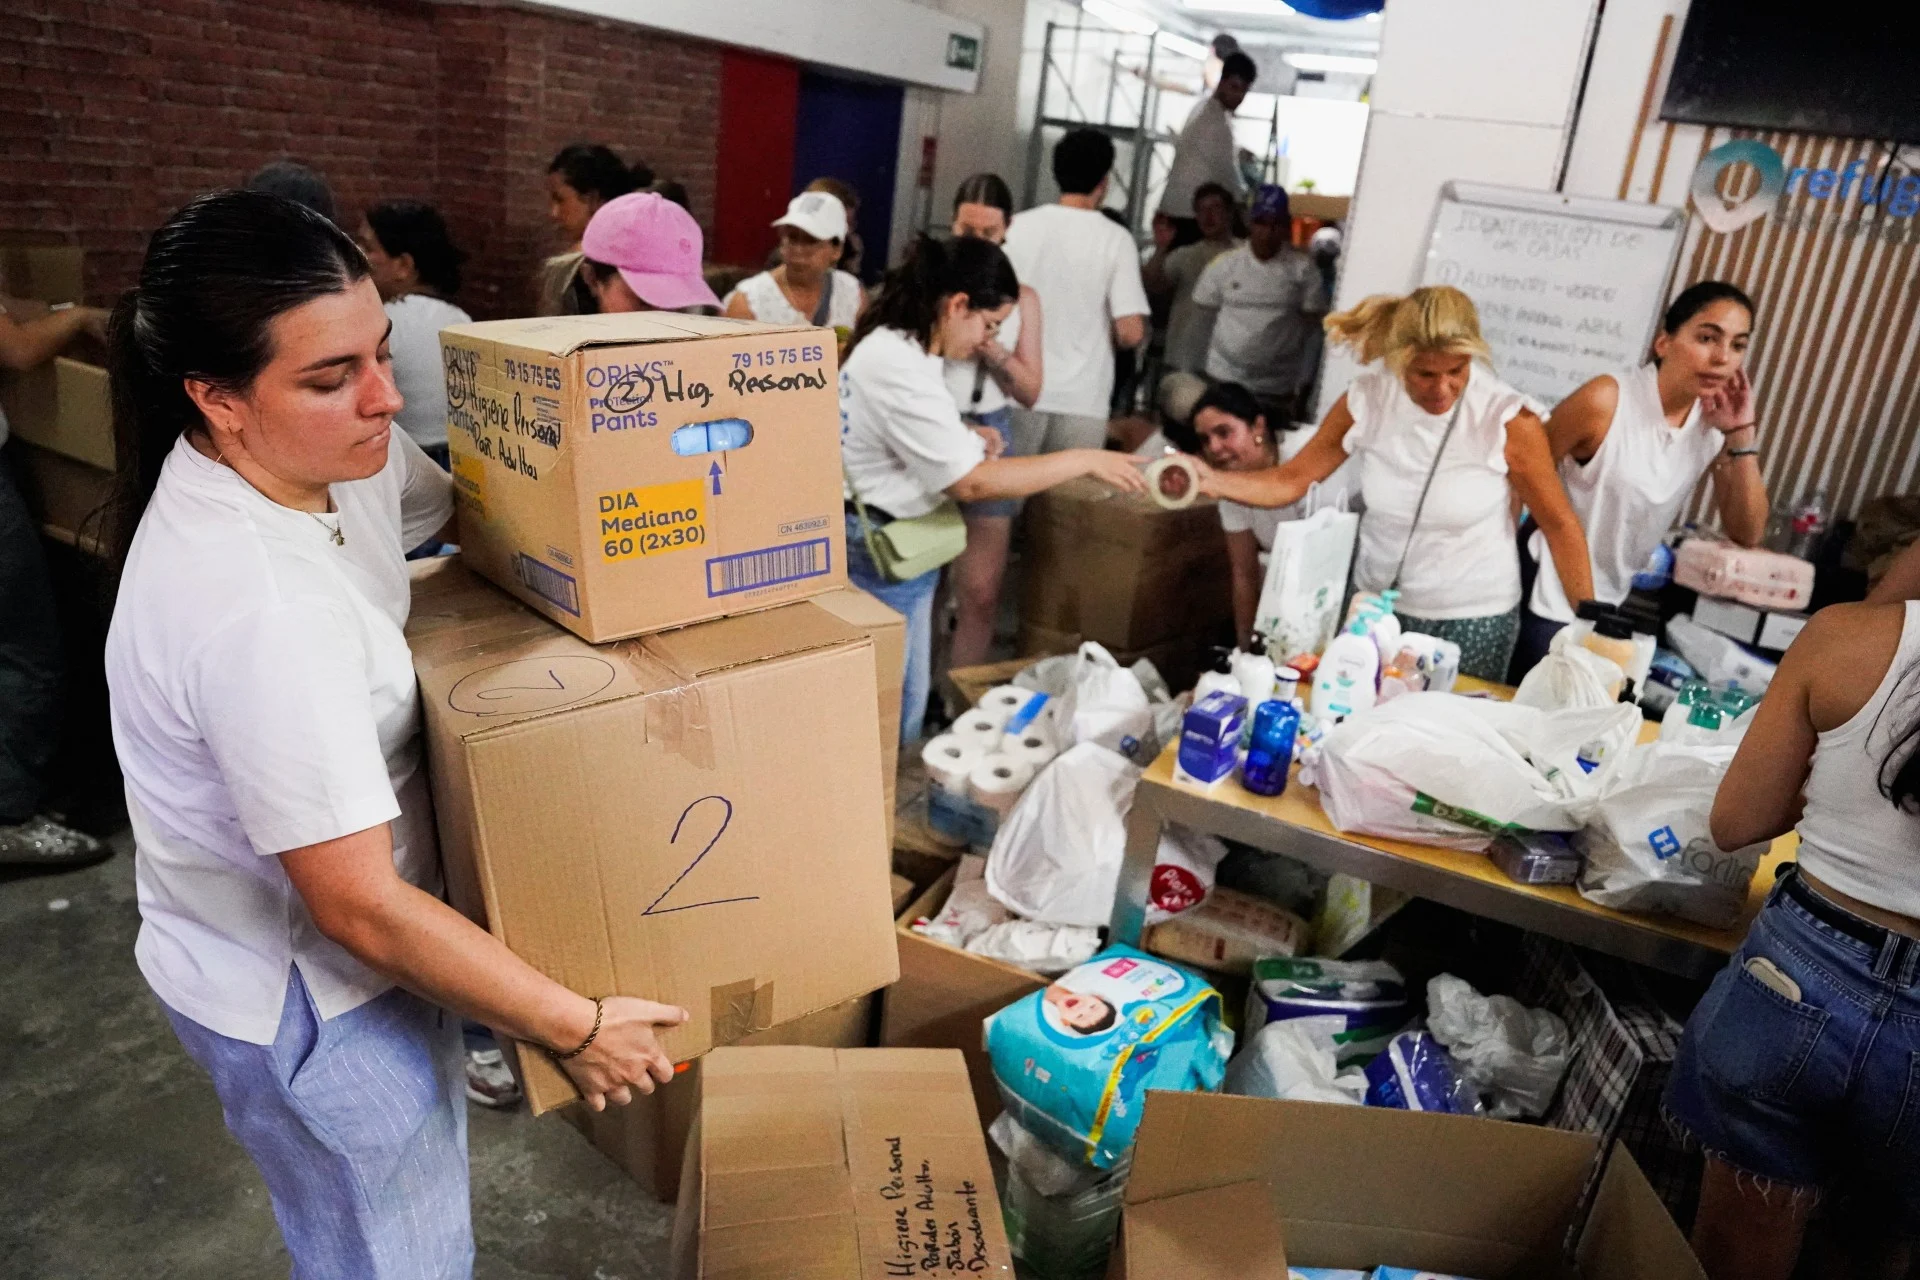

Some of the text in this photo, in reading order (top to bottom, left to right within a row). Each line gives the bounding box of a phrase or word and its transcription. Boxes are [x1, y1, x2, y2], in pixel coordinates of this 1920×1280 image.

[732, 346, 823, 369] 79 15 75 ES
[504, 358, 561, 391] 79 15 75 ES
[728, 368, 827, 396] Personal
[465, 361, 510, 433] Higiene
[592, 409, 658, 433] Pants
[599, 492, 640, 514] DIA
[601, 507, 698, 536] Mediano
[603, 537, 634, 558] 60
[640, 525, 706, 555] (2x30)
[641, 796, 760, 917] 2
[880, 1136, 919, 1276] Higiene Personal
